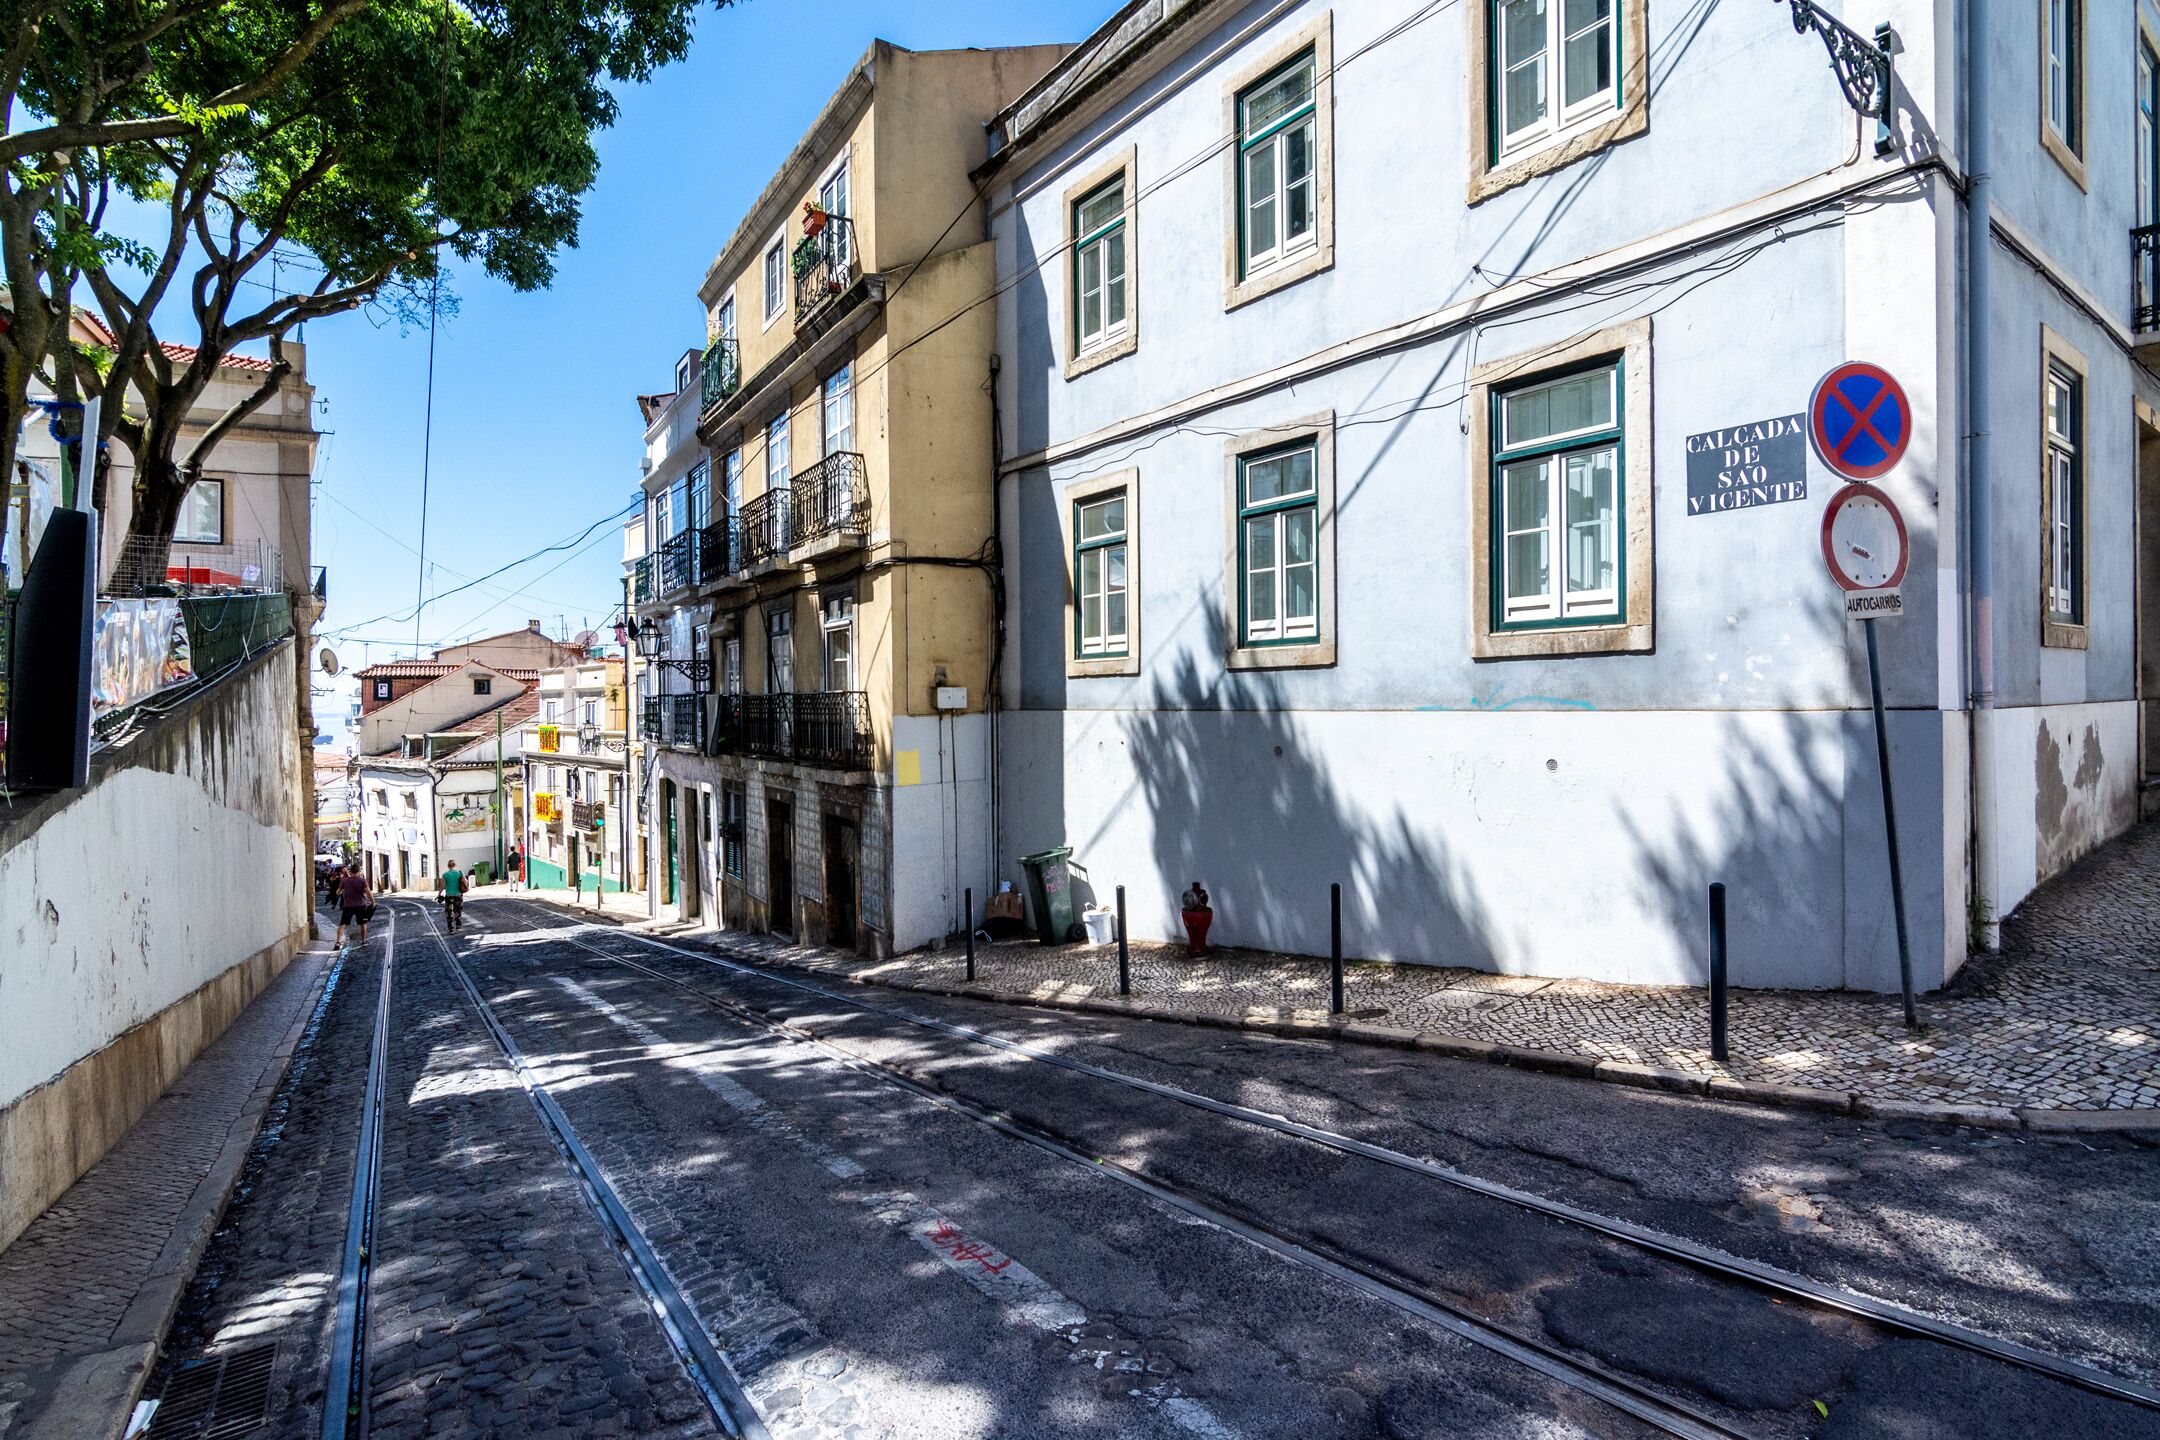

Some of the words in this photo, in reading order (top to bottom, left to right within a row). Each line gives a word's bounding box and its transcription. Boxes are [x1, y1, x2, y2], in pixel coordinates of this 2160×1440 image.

[1687, 417, 1801, 453] CALÇADA
[1725, 445, 1760, 467] DE
[1718, 465, 1767, 489] SÃO
[1690, 481, 1805, 513] VICENTE
